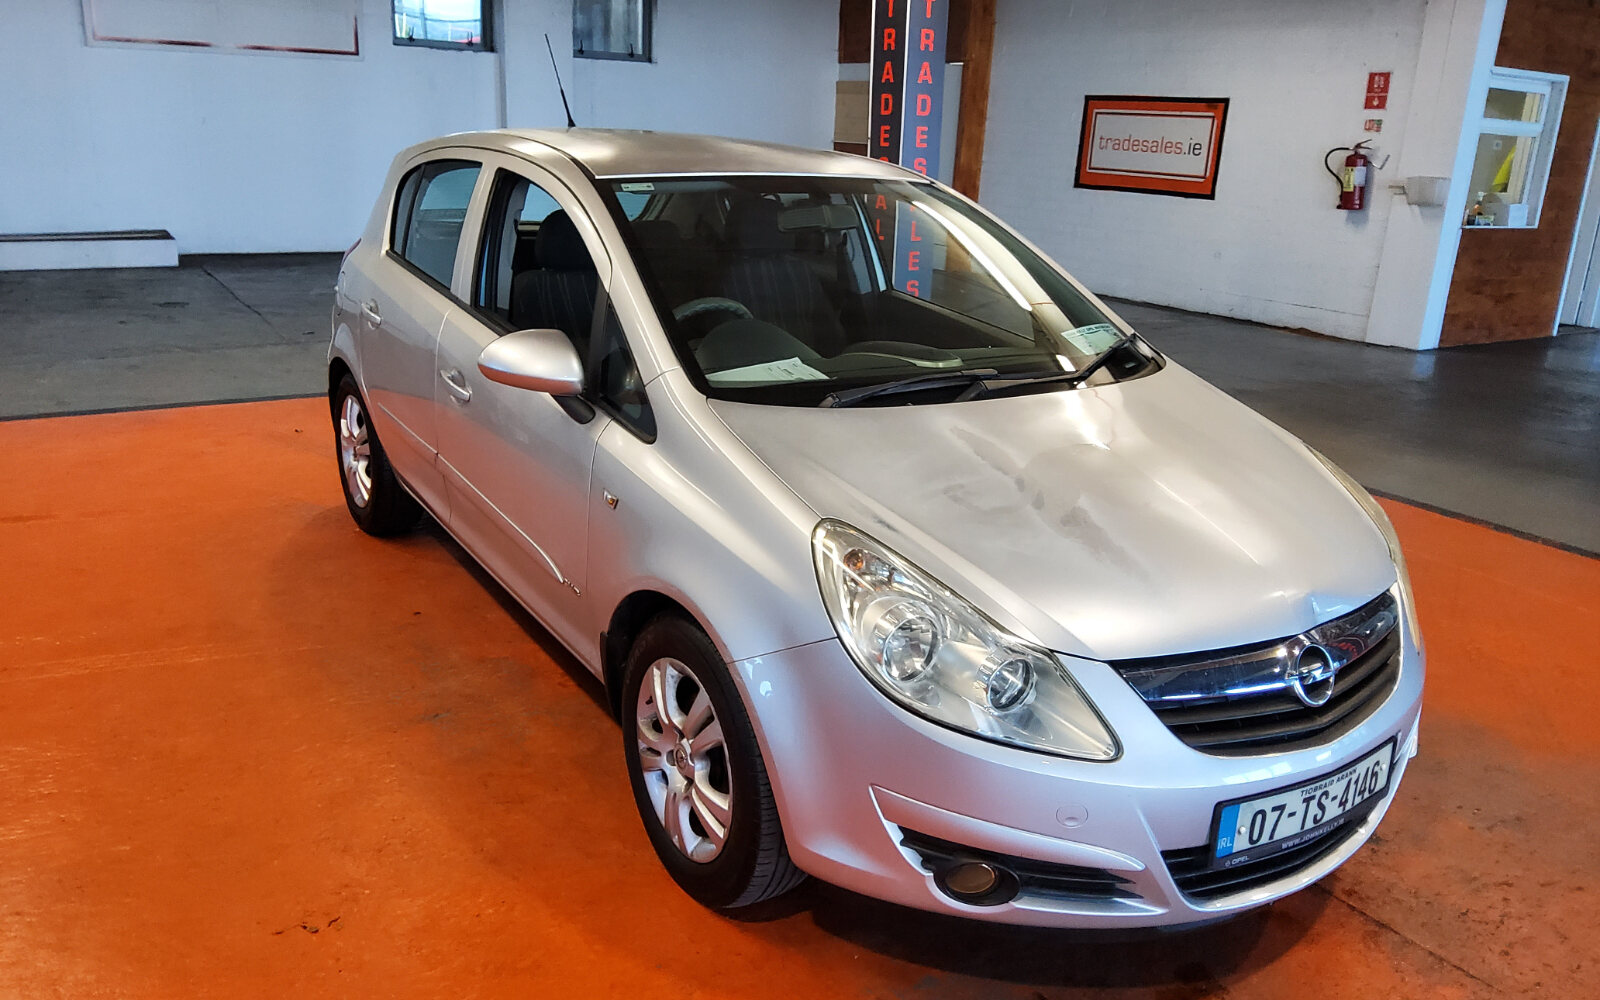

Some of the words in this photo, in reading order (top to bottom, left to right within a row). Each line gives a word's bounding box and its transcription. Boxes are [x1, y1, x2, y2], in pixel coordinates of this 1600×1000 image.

[906, 0, 936, 298] TRADESLES
[1098, 134, 1203, 156] tradesales.ie
[1300, 779, 1335, 796] TIOBRAID
[1248, 760, 1380, 845] 07-TS-4146
[1217, 836, 1233, 851] IRL
[1231, 855, 1249, 865] OPEL
